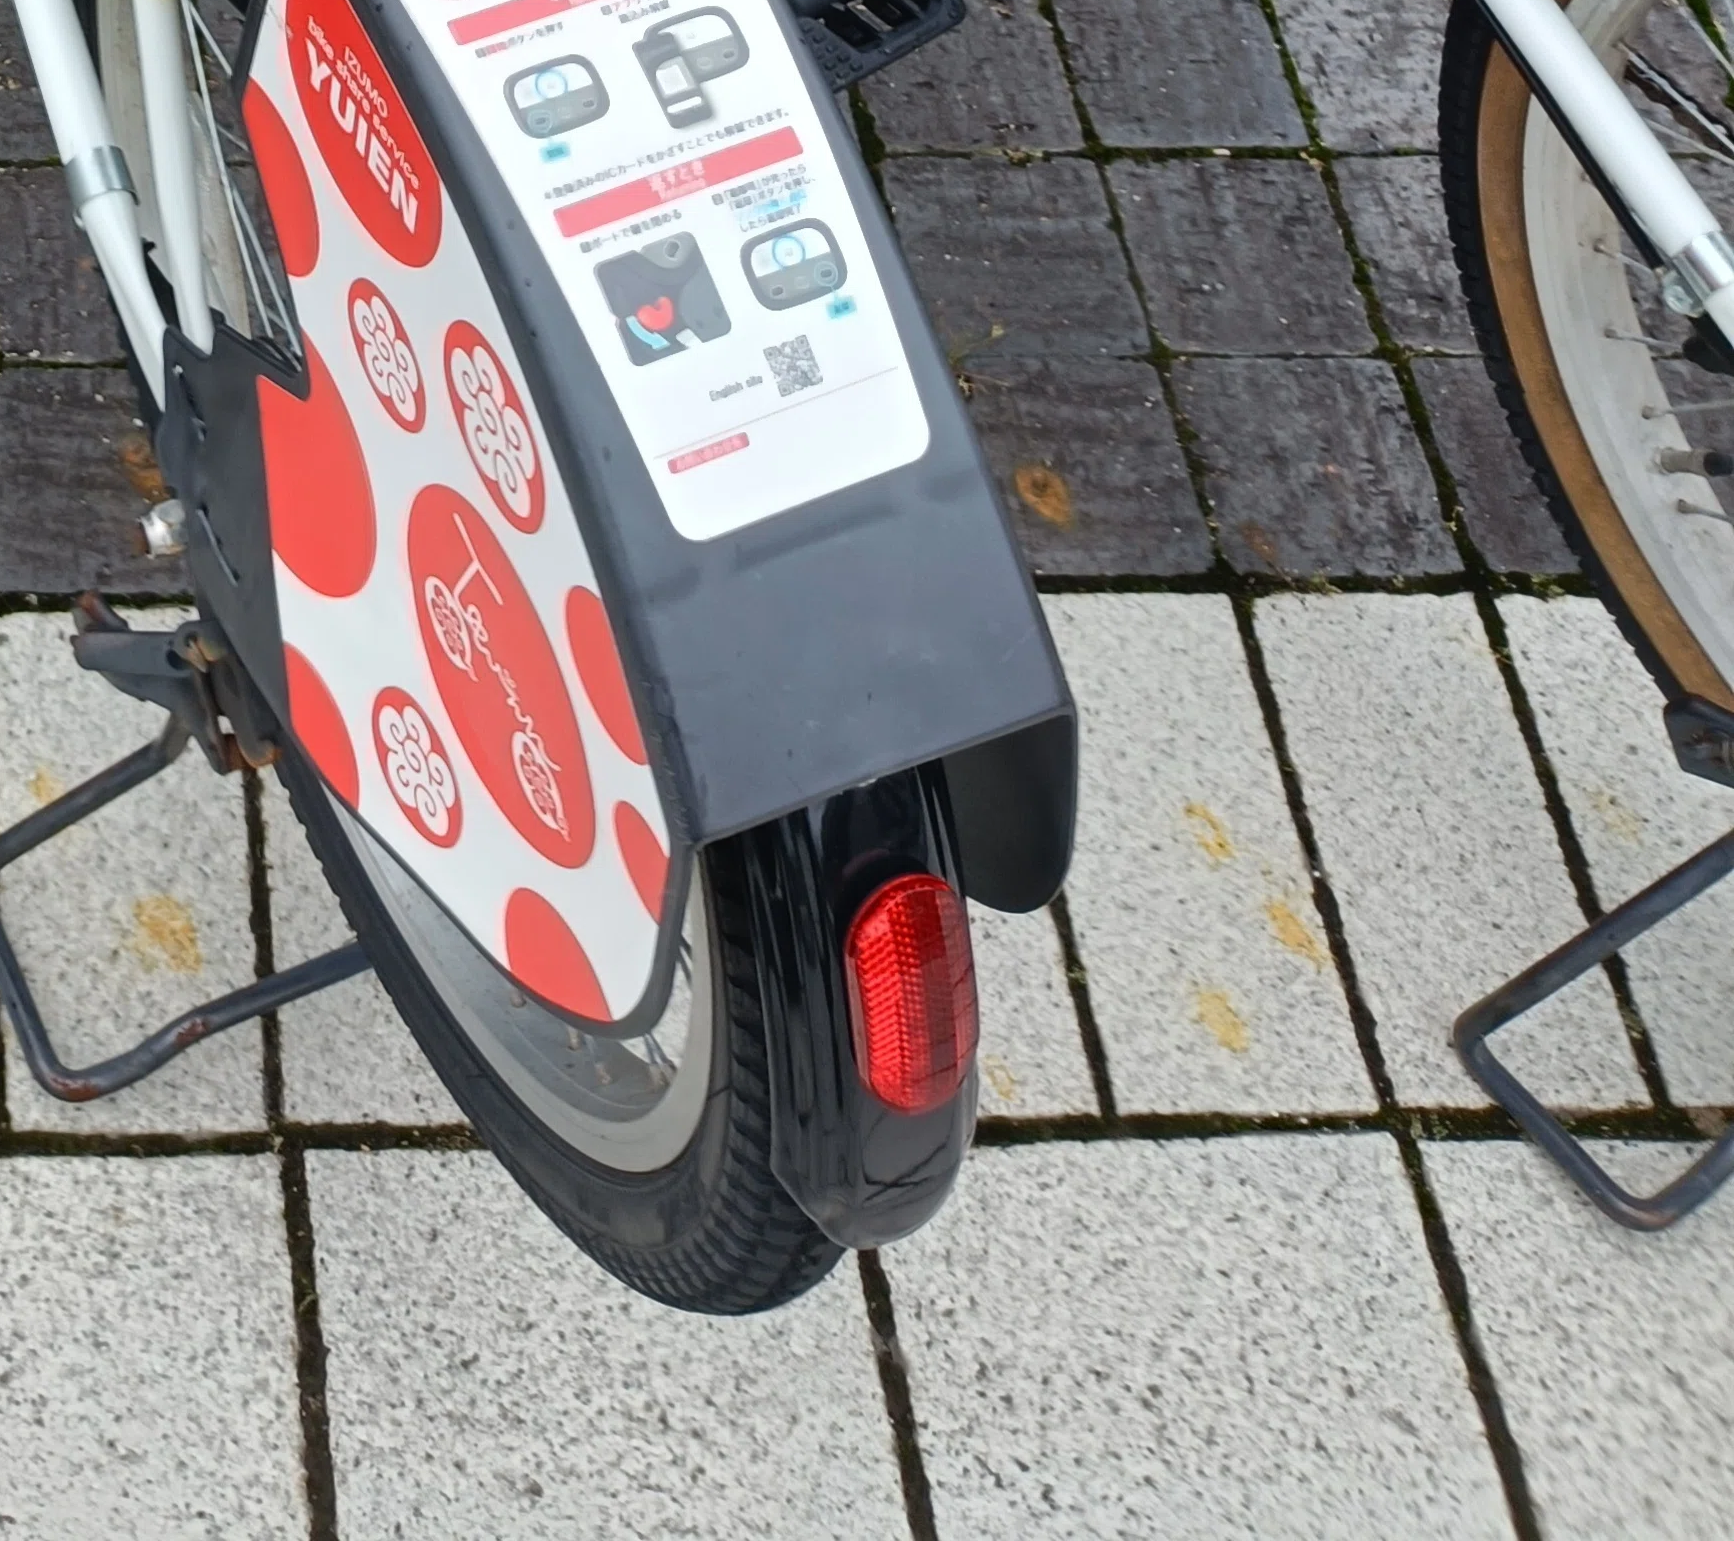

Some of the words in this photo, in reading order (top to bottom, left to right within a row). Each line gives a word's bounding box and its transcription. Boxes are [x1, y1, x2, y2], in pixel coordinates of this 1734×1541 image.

[304, 36, 419, 235] YUIEN
[307, 14, 335, 60] bike
[334, 58, 371, 115] share
[371, 113, 420, 190] service
[343, 45, 388, 120] IZUMO
